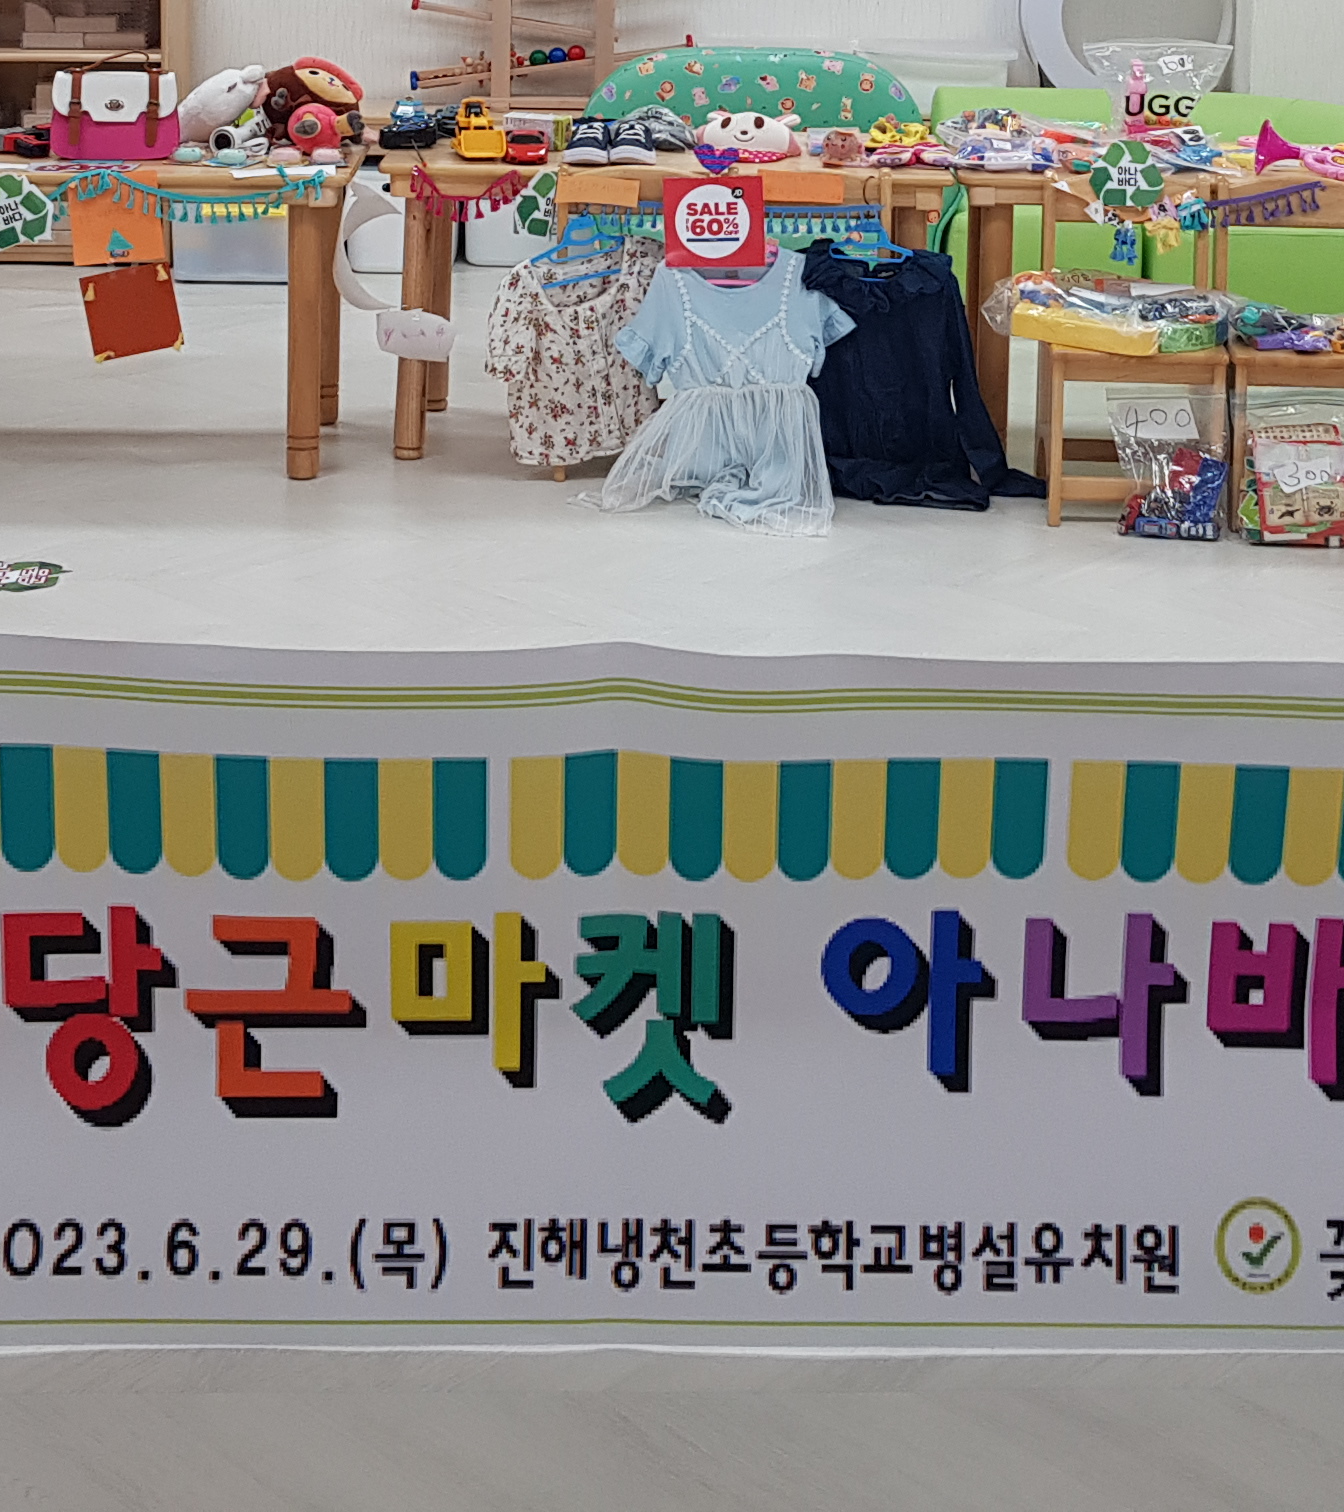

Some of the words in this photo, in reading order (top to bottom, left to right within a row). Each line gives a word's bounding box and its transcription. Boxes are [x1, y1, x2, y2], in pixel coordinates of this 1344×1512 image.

[1124, 94, 1199, 117] UGG
[1117, 166, 1139, 176] 아나
[1117, 177, 1140, 187] 바다
[3, 211, 23, 226] 바다
[686, 202, 739, 216] SALE
[690, 217, 739, 237] 60%
[1124, 405, 1192, 438] 400
[1282, 461, 1331, 487] 300
[0, 904, 736, 1128] 당근마켓
[487, 1215, 1182, 1295] 진해냉천초등학교병설유치원
